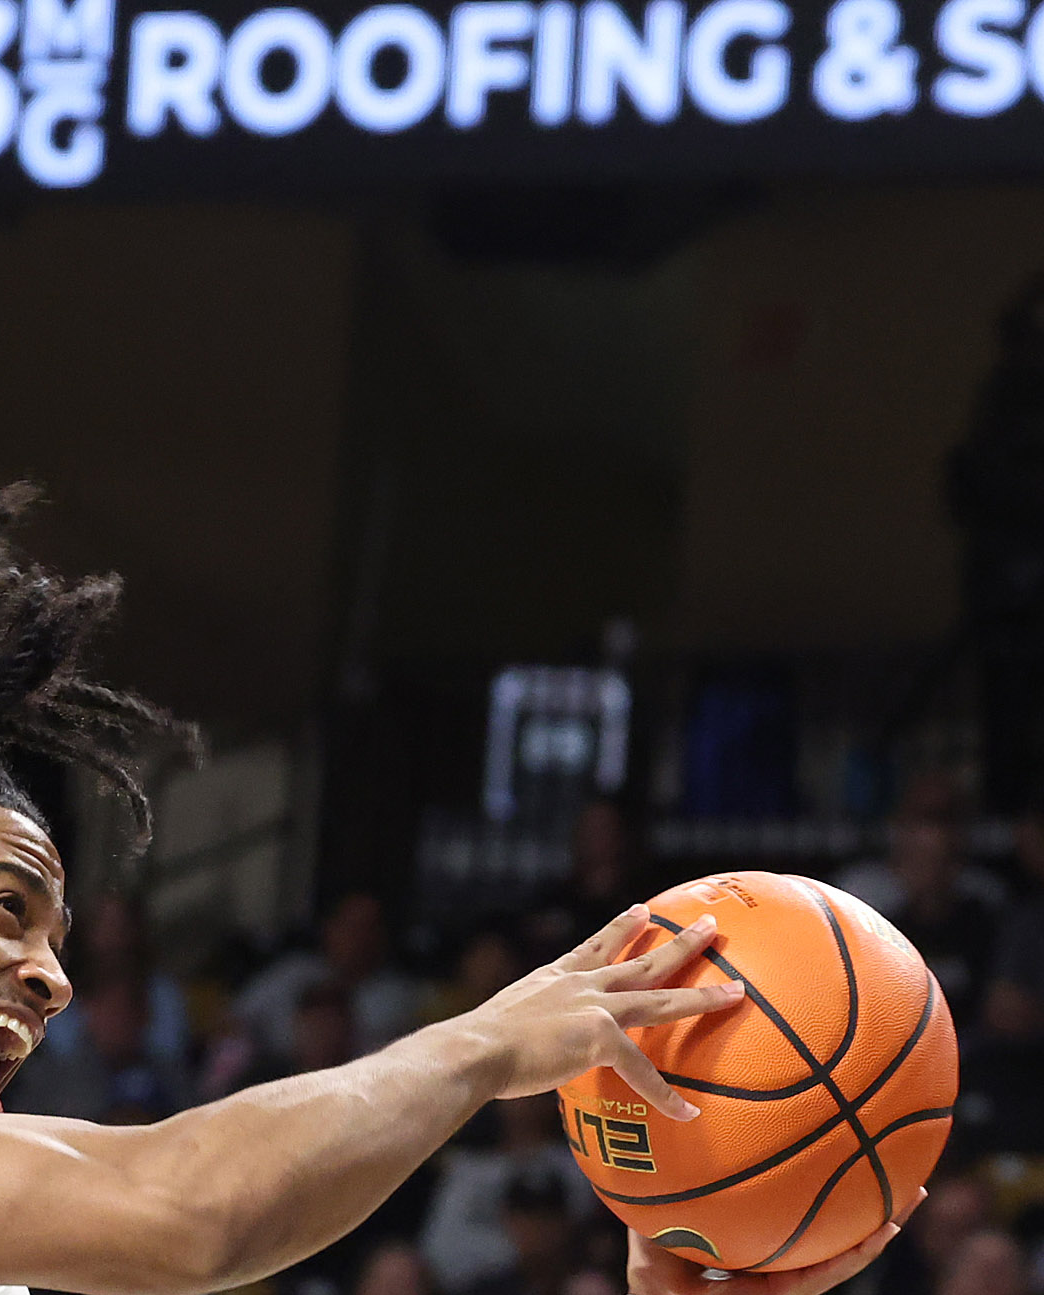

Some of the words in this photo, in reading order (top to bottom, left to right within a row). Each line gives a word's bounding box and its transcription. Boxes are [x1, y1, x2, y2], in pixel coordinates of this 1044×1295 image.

[125, 0, 792, 136] ROOFING
[812, 0, 920, 122] &
[931, 0, 1044, 118] S
